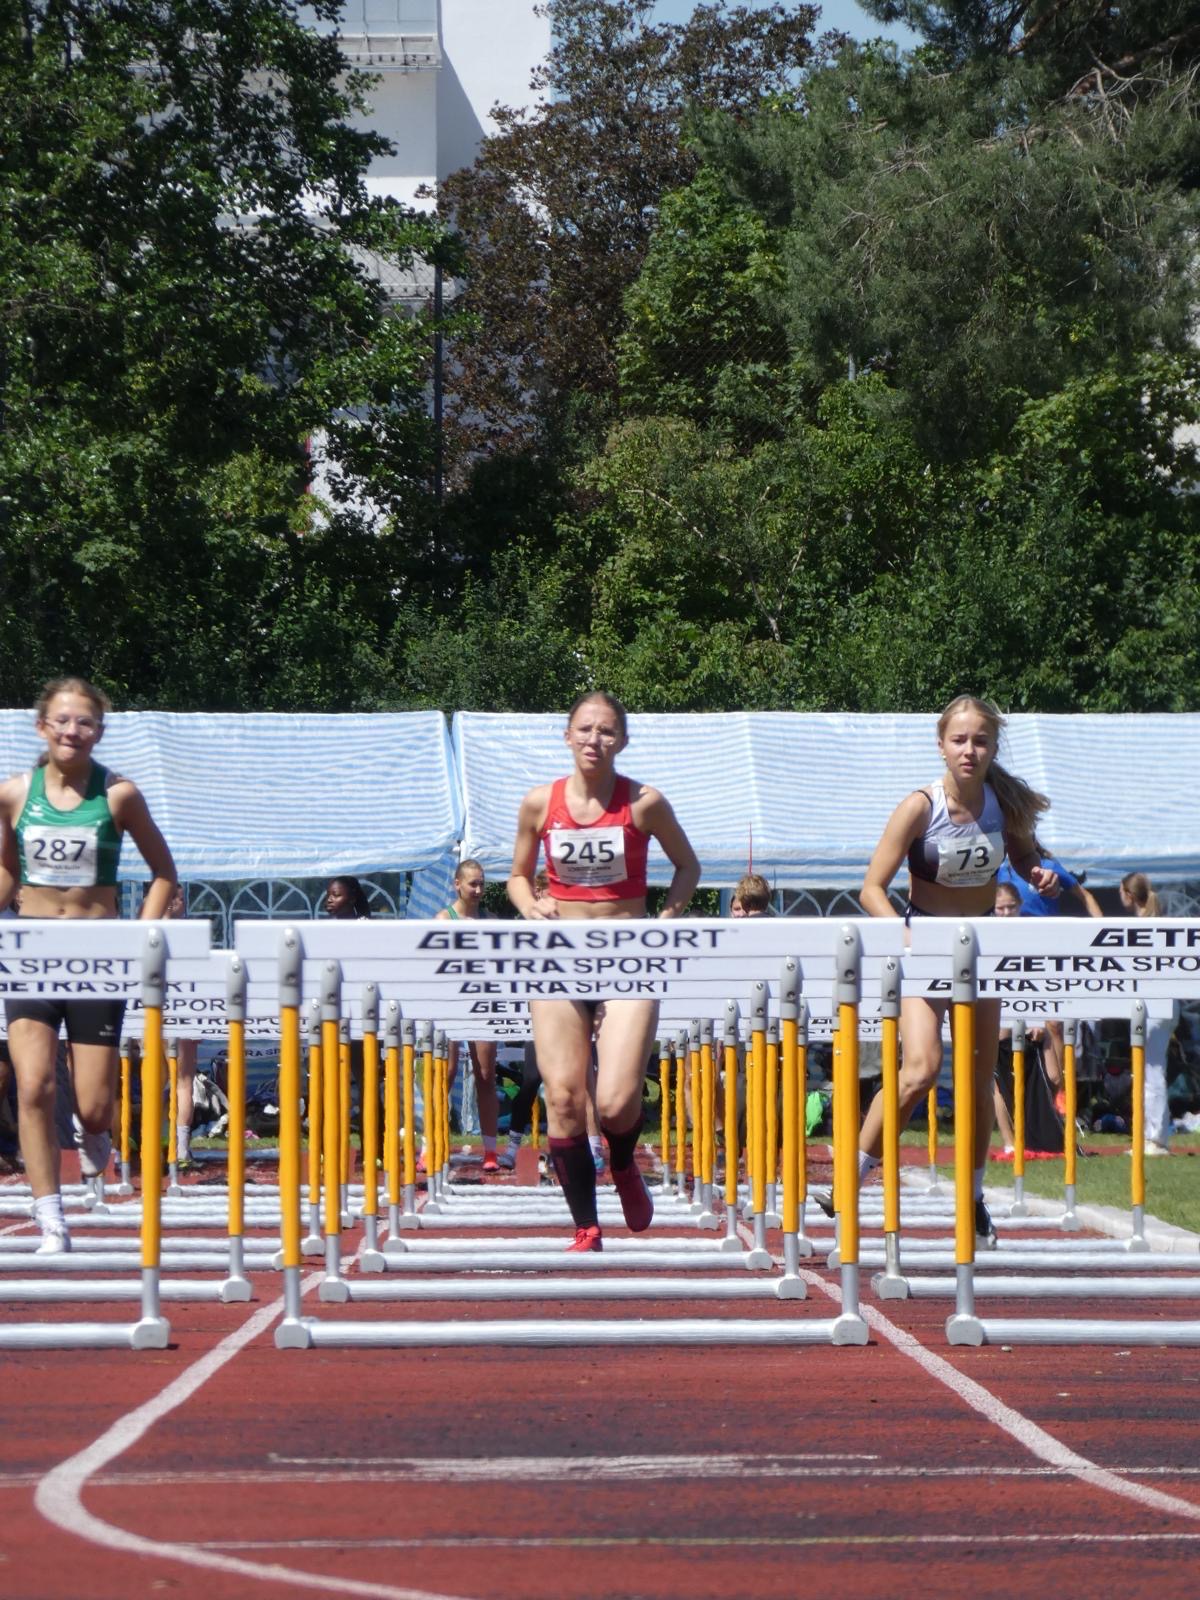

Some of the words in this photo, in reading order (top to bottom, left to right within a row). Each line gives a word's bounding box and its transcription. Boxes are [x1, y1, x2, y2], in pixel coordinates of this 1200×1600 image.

[31, 838, 87, 862] 287
[560, 840, 615, 865] 245
[956, 845, 990, 871] 73
[416, 931, 576, 950] GETRA
[585, 929, 726, 949] SPORT
[20, 959, 136, 975] SPORT
[434, 959, 567, 974] GETRA
[573, 957, 690, 974] SPORT
[994, 956, 1126, 972] GETRA
[103, 981, 196, 993] SPRT
[458, 981, 570, 994] GETRA
[575, 981, 668, 993] SPORT
[927, 979, 1039, 992] GTRA
[1045, 979, 1138, 992] SPORT
[469, 1001, 531, 1013] GET
